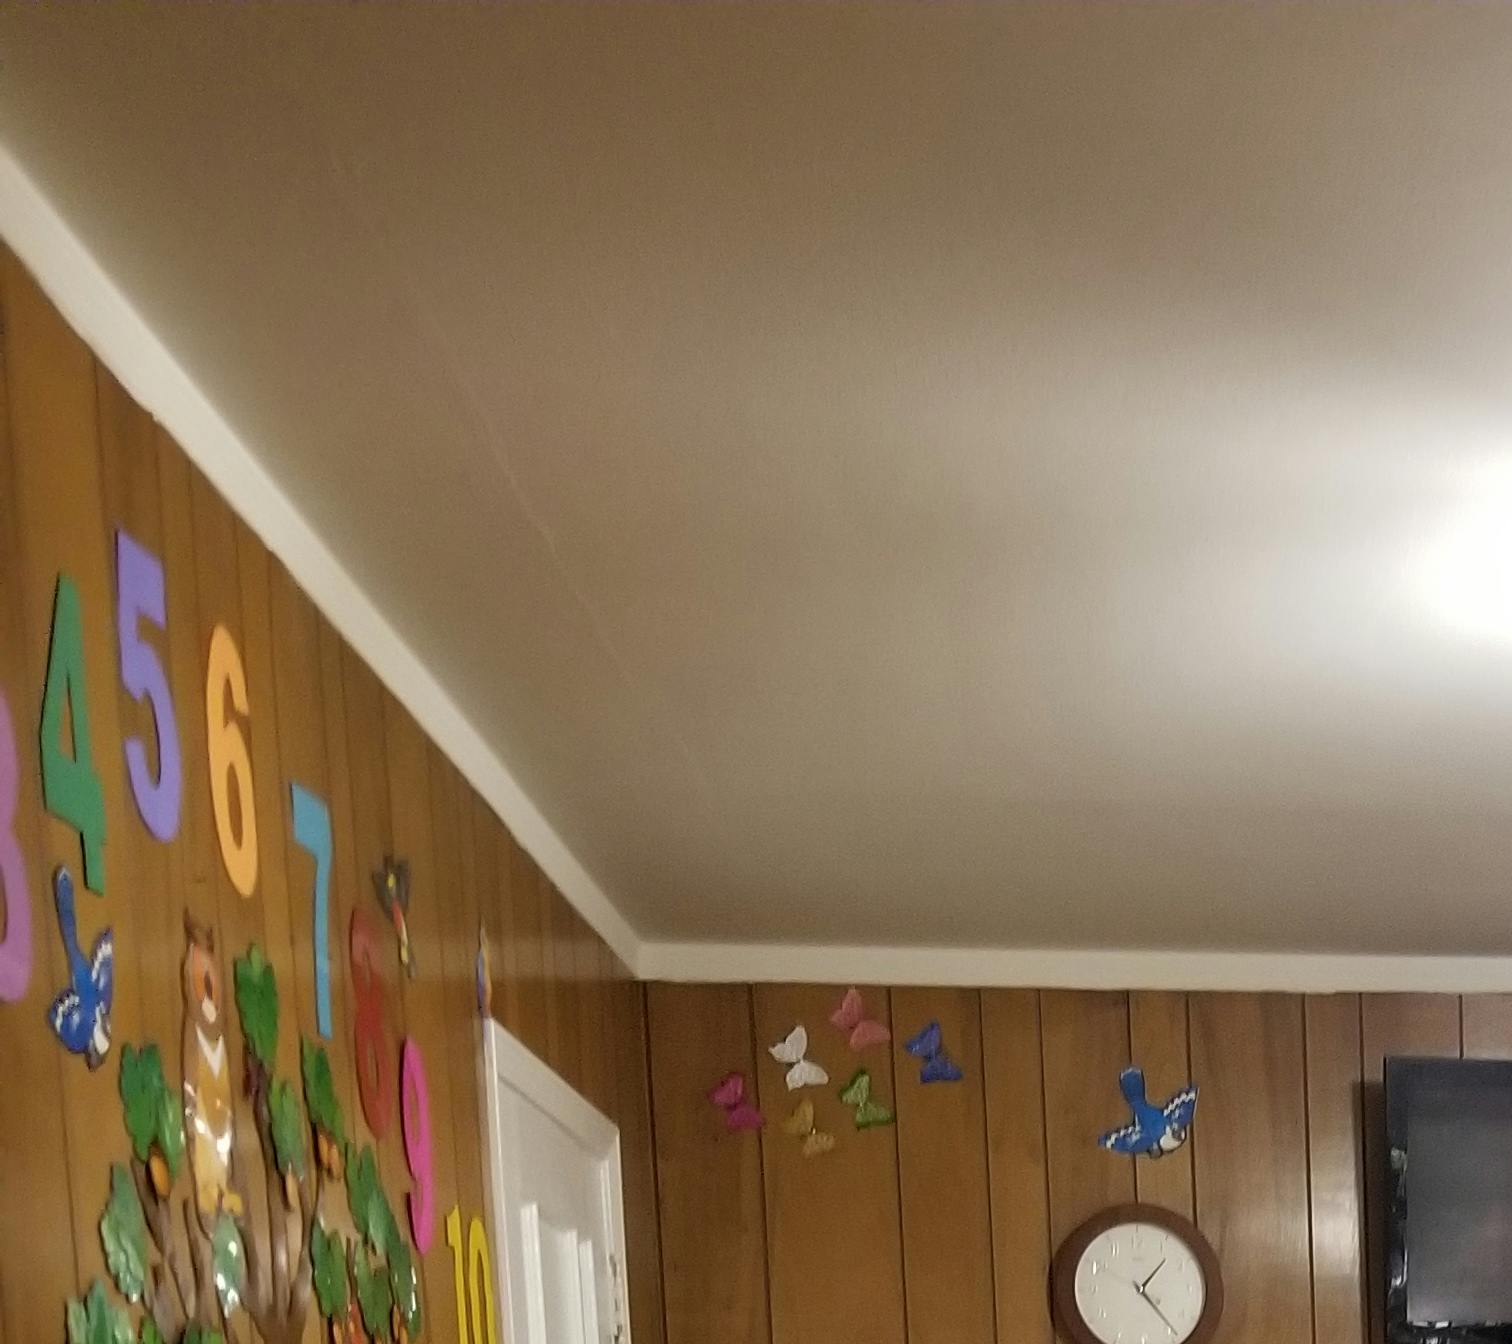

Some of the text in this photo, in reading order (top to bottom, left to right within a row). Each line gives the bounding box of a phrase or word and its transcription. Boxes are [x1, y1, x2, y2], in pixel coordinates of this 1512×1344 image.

[40, 570, 107, 897] 4
[113, 527, 181, 844] 5
[206, 624, 258, 898] 6
[290, 780, 332, 1040] 7
[349, 907, 391, 1141] 8
[402, 1034, 431, 1256] 9
